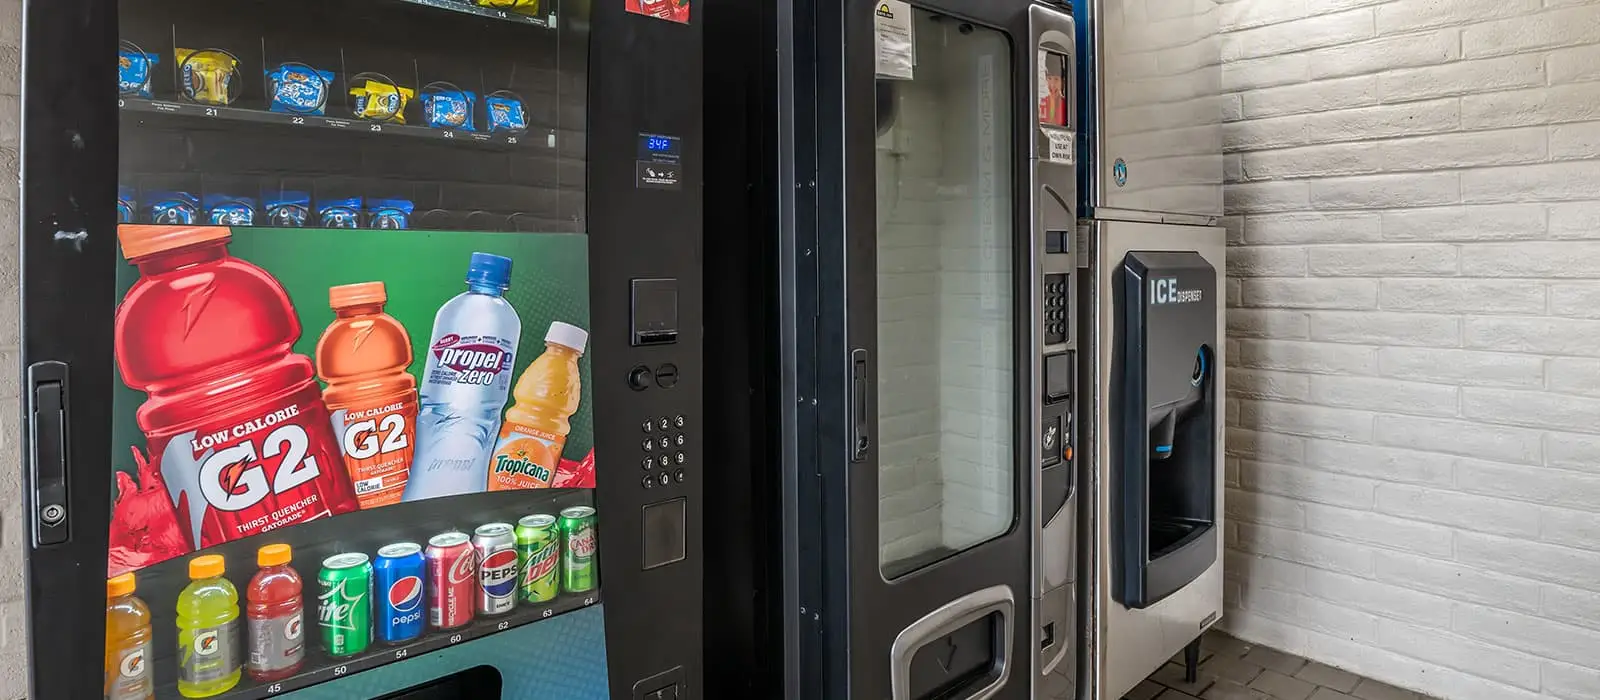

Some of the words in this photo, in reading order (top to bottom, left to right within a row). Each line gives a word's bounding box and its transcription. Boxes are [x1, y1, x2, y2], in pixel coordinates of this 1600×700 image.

[206, 108, 218, 117] 21
[292, 117, 304, 125] 22
[371, 124, 381, 132] 23
[649, 138, 668, 150] 34F
[1151, 278, 1177, 304] ICE
[437, 347, 503, 370] propel
[457, 369, 495, 386] zero
[344, 411, 365, 420] LOW
[366, 402, 404, 417] CALORIE
[191, 430, 229, 451] LOW
[232, 404, 299, 438] CALORIE
[646, 421, 651, 431] 1
[661, 418, 668, 428] 2
[677, 416, 684, 426] 3
[344, 413, 409, 460] G2
[514, 425, 539, 435] ORANGE
[539, 431, 556, 440] JUICE
[646, 439, 652, 450] 4
[662, 437, 668, 447] 5
[677, 435, 684, 445] 6
[199, 424, 320, 512] G2
[495, 454, 550, 482] Tropicana
[647, 459, 653, 469] 7
[662, 456, 668, 465] 8
[678, 453, 684, 463] 9
[496, 475, 516, 485] 100%
[662, 474, 668, 484] 0
[237, 515, 269, 533] THIRST
[271, 494, 318, 520] QUENCHER
[392, 611, 421, 626] pepsi
[543, 609, 552, 618] 63
[498, 621, 509, 630] 62
[194, 630, 218, 656] G
[450, 634, 461, 644] 60
[395, 650, 407, 659] 54
[120, 649, 145, 678] G
[334, 666, 347, 676] 50
[267, 684, 281, 693] 45
